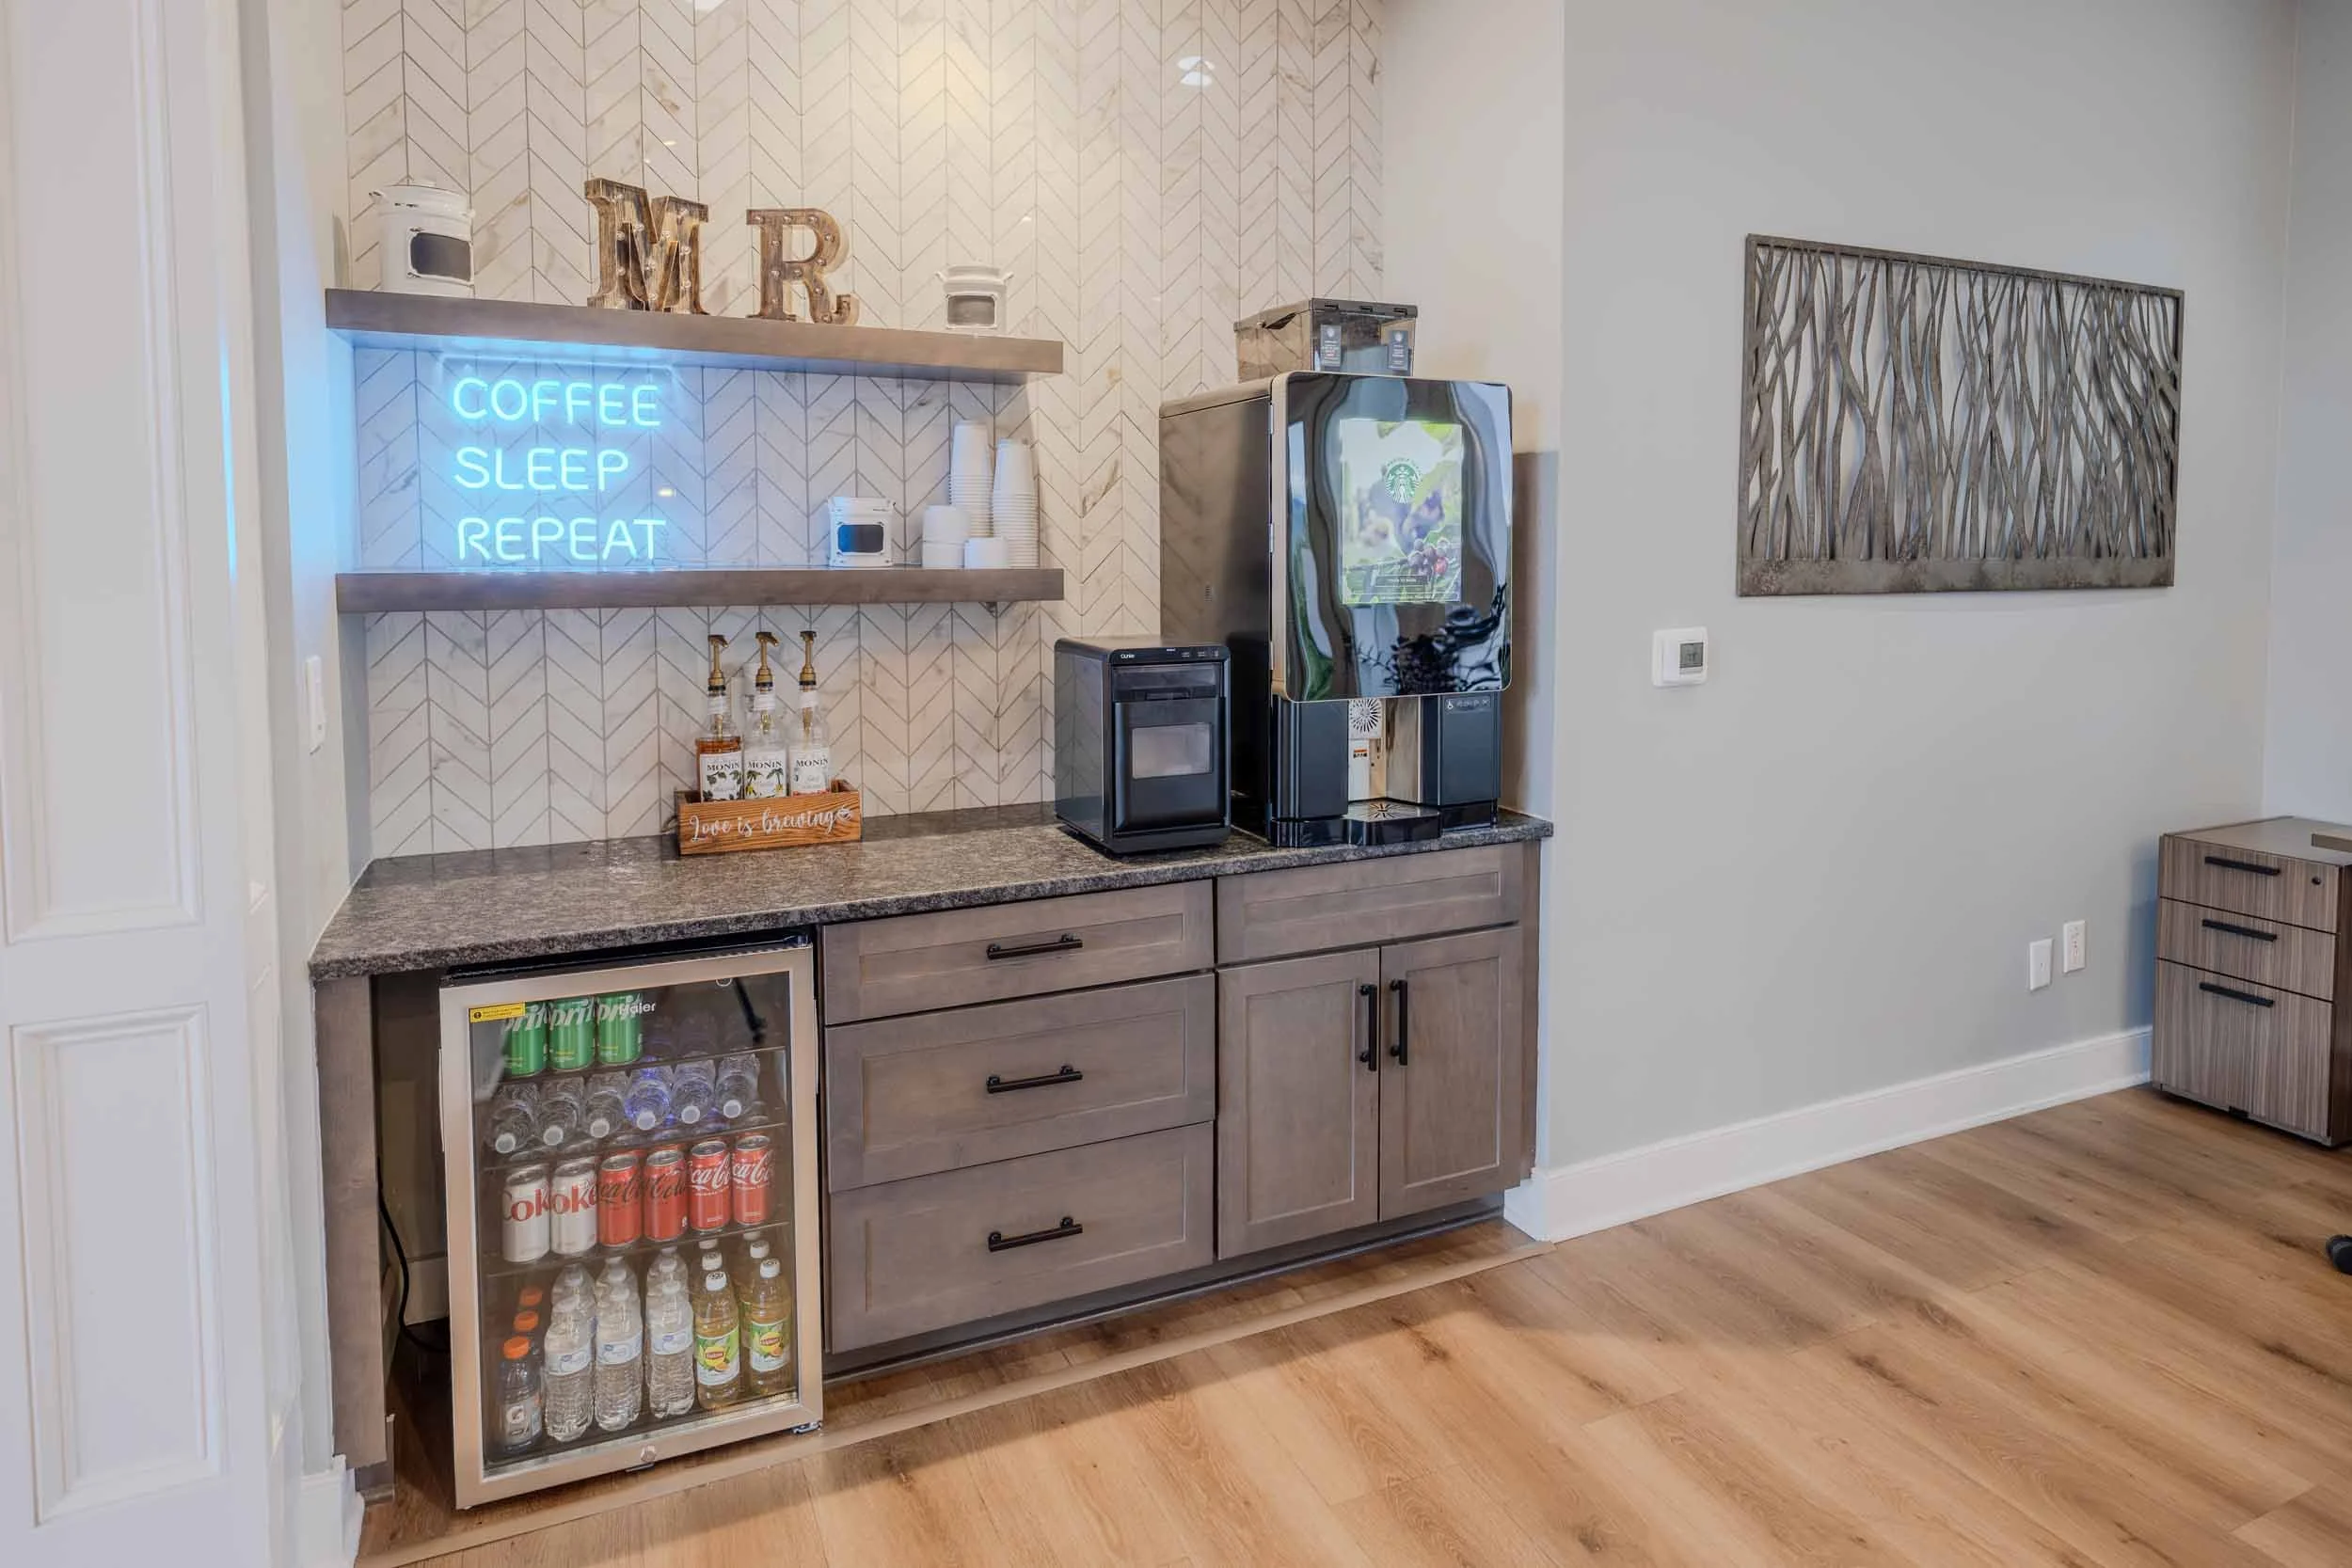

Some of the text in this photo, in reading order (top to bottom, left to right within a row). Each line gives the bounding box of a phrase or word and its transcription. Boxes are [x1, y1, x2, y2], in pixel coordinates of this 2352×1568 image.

[453, 377, 661, 426] COFFEE
[453, 446, 628, 492] SLEEP
[457, 516, 667, 562] REPEAT
[707, 762, 739, 772] MONIN
[747, 760, 783, 769] MONIN
[795, 757, 829, 768] MONIN
[689, 807, 836, 843] Love is brewing
